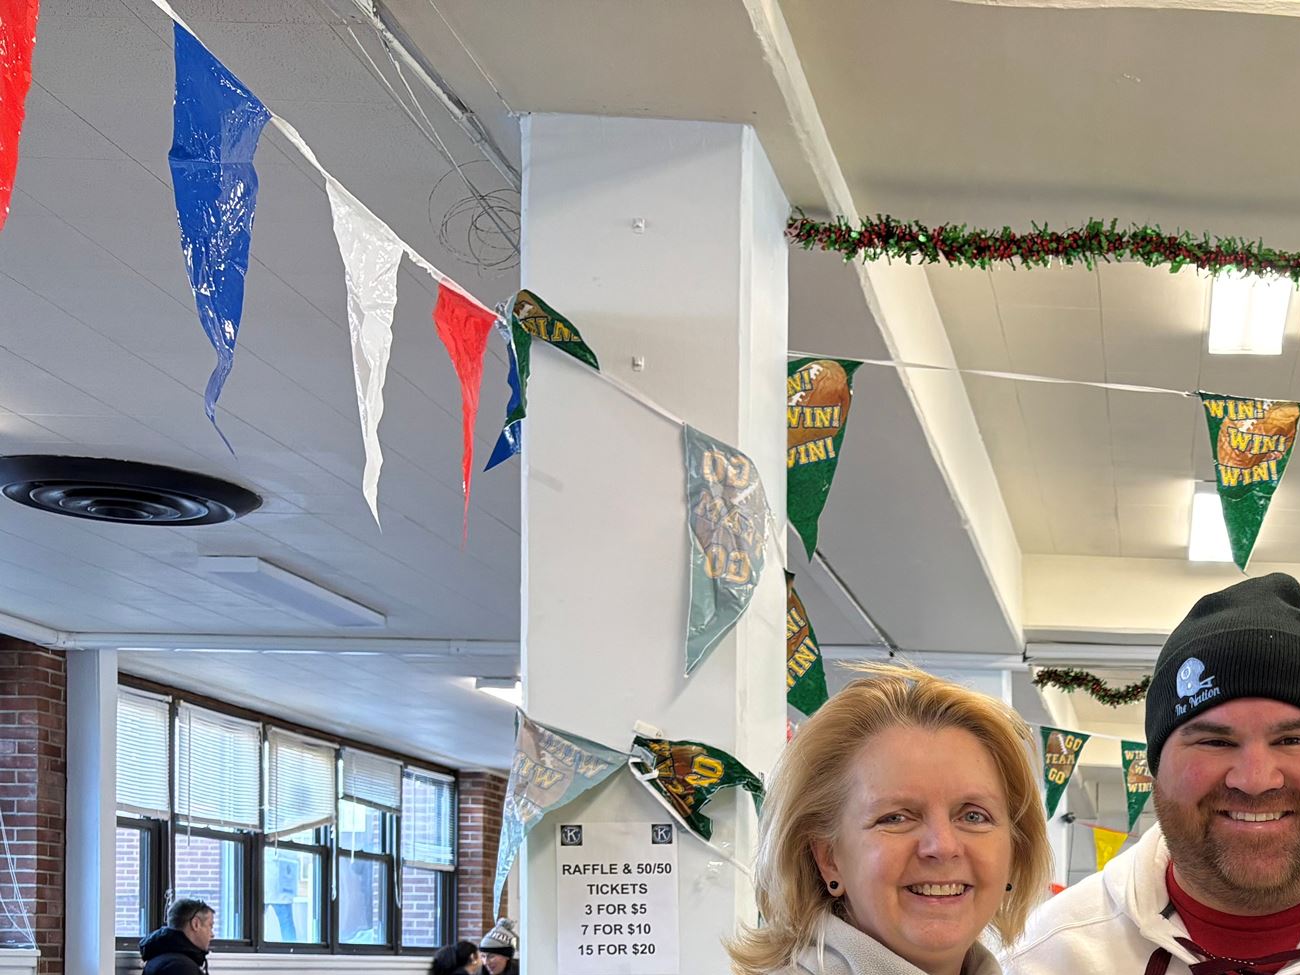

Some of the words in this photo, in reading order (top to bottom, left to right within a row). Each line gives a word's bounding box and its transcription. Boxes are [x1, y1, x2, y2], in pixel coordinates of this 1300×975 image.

[1203, 400, 1264, 420] WIN!
[1228, 428, 1287, 454] WIN!
[1219, 460, 1278, 487] WIN!
[1064, 735, 1083, 751] GO
[1046, 753, 1076, 765] TEAM
[1048, 768, 1066, 785] GO
[562, 864, 618, 875] RAFFLE
[622, 863, 632, 874] &
[637, 863, 672, 874] 50/50
[587, 883, 648, 895] TICKETS
[585, 904, 592, 915] 3
[597, 904, 627, 914] FOR
[631, 903, 647, 915] $5
[581, 924, 588, 935] 7
[593, 924, 623, 935] FOR
[627, 923, 651, 935] $10
[578, 944, 594, 955] 15
[598, 944, 628, 955] FOR
[632, 943, 656, 955] $20
